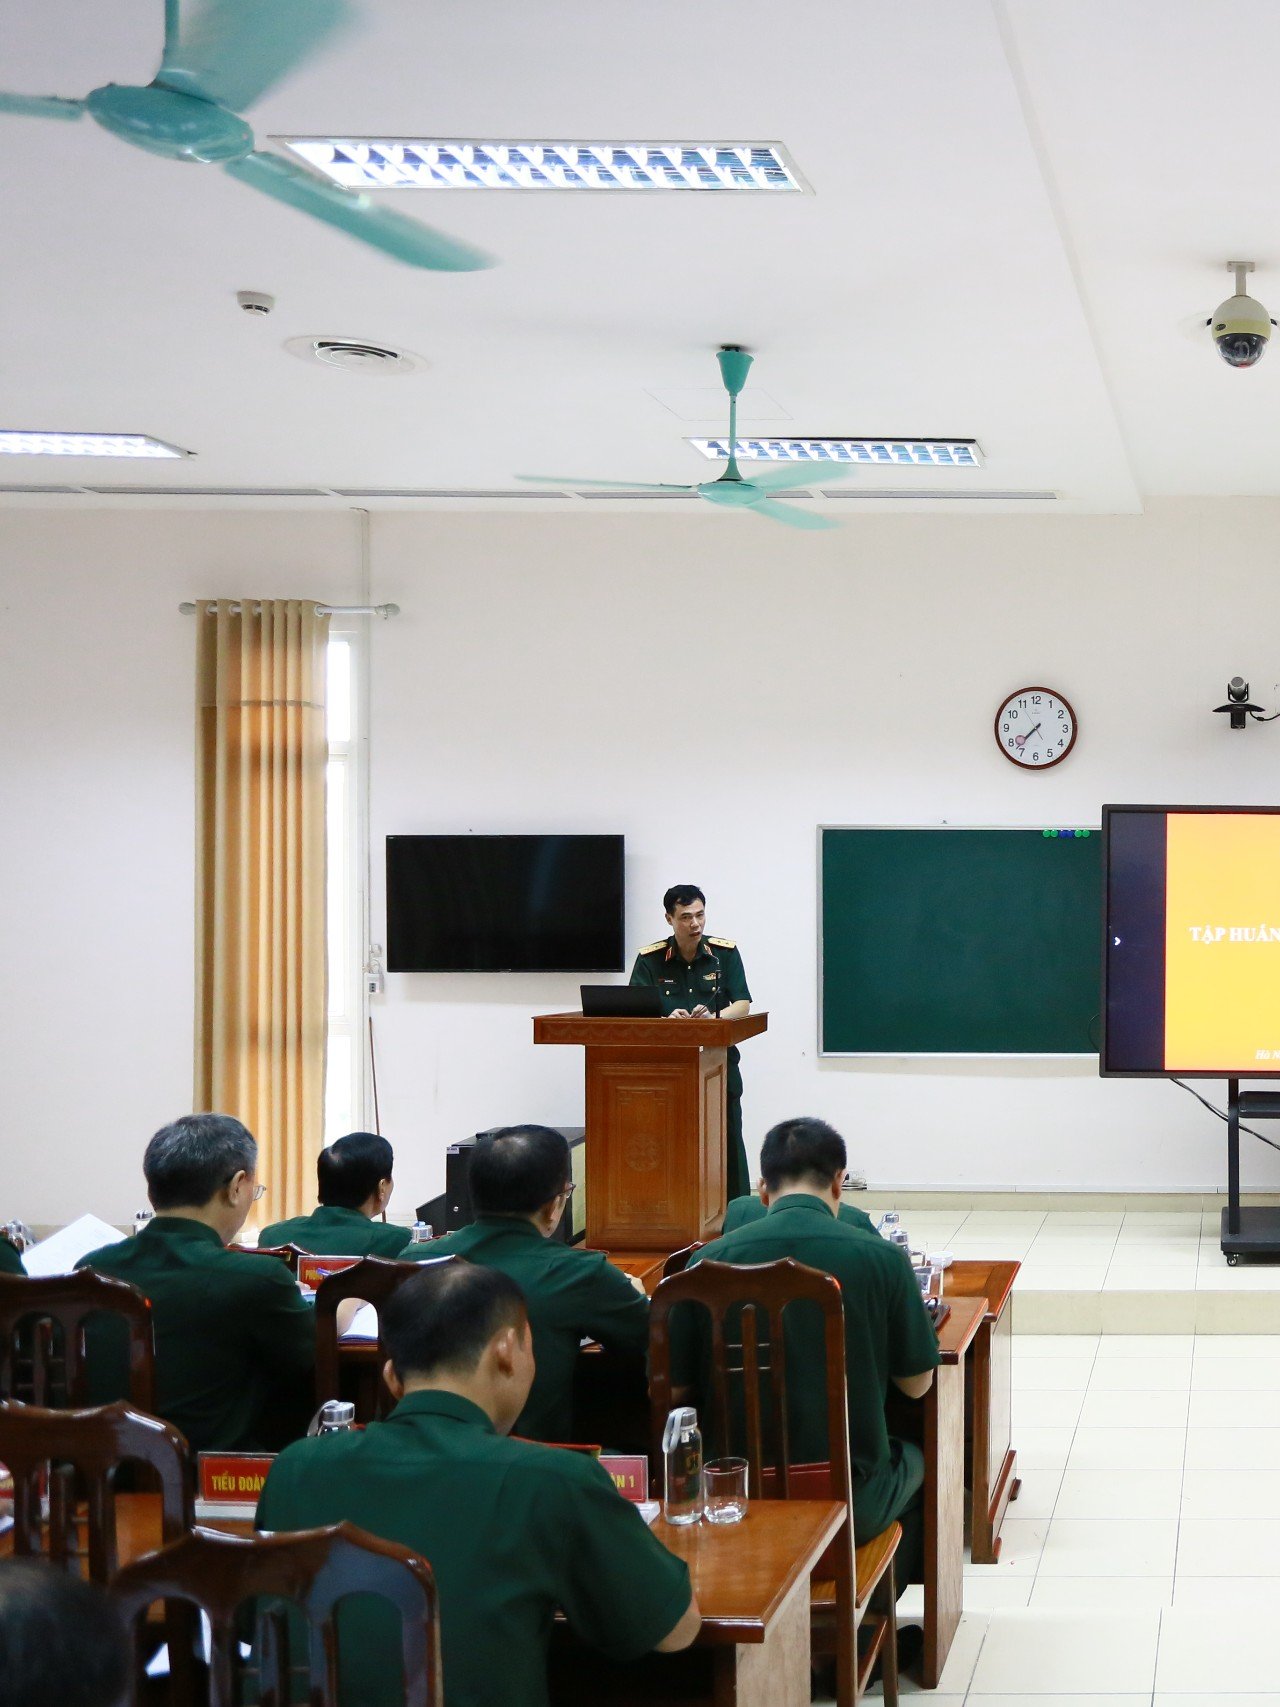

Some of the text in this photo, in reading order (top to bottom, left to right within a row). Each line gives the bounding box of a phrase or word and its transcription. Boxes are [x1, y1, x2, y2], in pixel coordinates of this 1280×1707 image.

[1018, 700, 1027, 708] 11
[1031, 696, 1042, 704] 12
[1048, 700, 1053, 708] 1
[1008, 710, 1018, 719] 10
[1058, 710, 1064, 719] 2
[1003, 724, 1009, 732] 9
[1062, 724, 1069, 733] 3
[1008, 738, 1014, 747] 8
[1057, 739, 1064, 747] 4
[1019, 748, 1025, 757] 7
[1032, 752, 1039, 761] 6
[1047, 749, 1053, 758] 5
[1189, 924, 1226, 945] TẬP
[212, 1470, 236, 1491] TIỂU
[629, 1475, 635, 1488] 1
